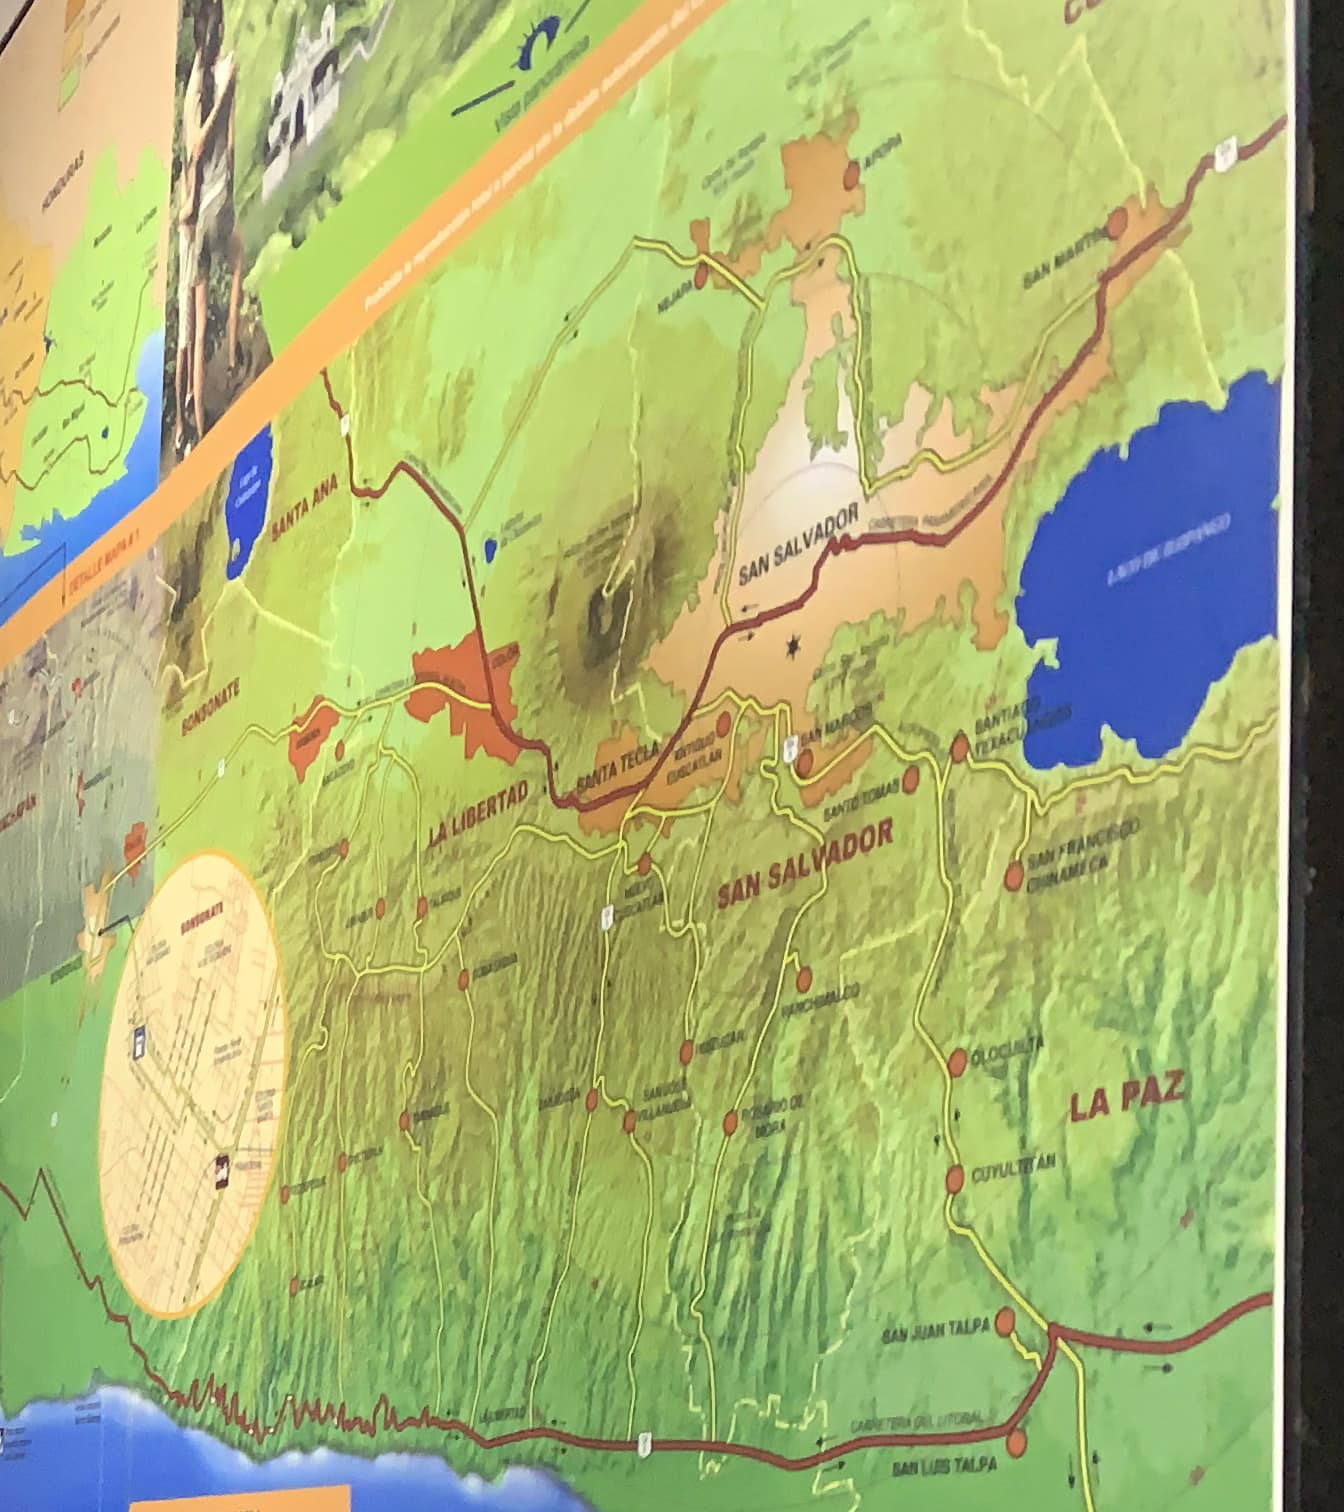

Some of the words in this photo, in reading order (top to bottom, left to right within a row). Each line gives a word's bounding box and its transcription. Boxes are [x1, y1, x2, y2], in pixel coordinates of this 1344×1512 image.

[739, 553, 769, 586] SAN
[773, 502, 859, 567] SALVADOR
[427, 820, 450, 850] LA
[451, 779, 530, 841] LIBERTAD
[717, 871, 761, 910] SAN
[768, 817, 894, 890] SALVADOR
[1070, 1086, 1108, 1124] LA
[1121, 1069, 1187, 1112] PAZ
